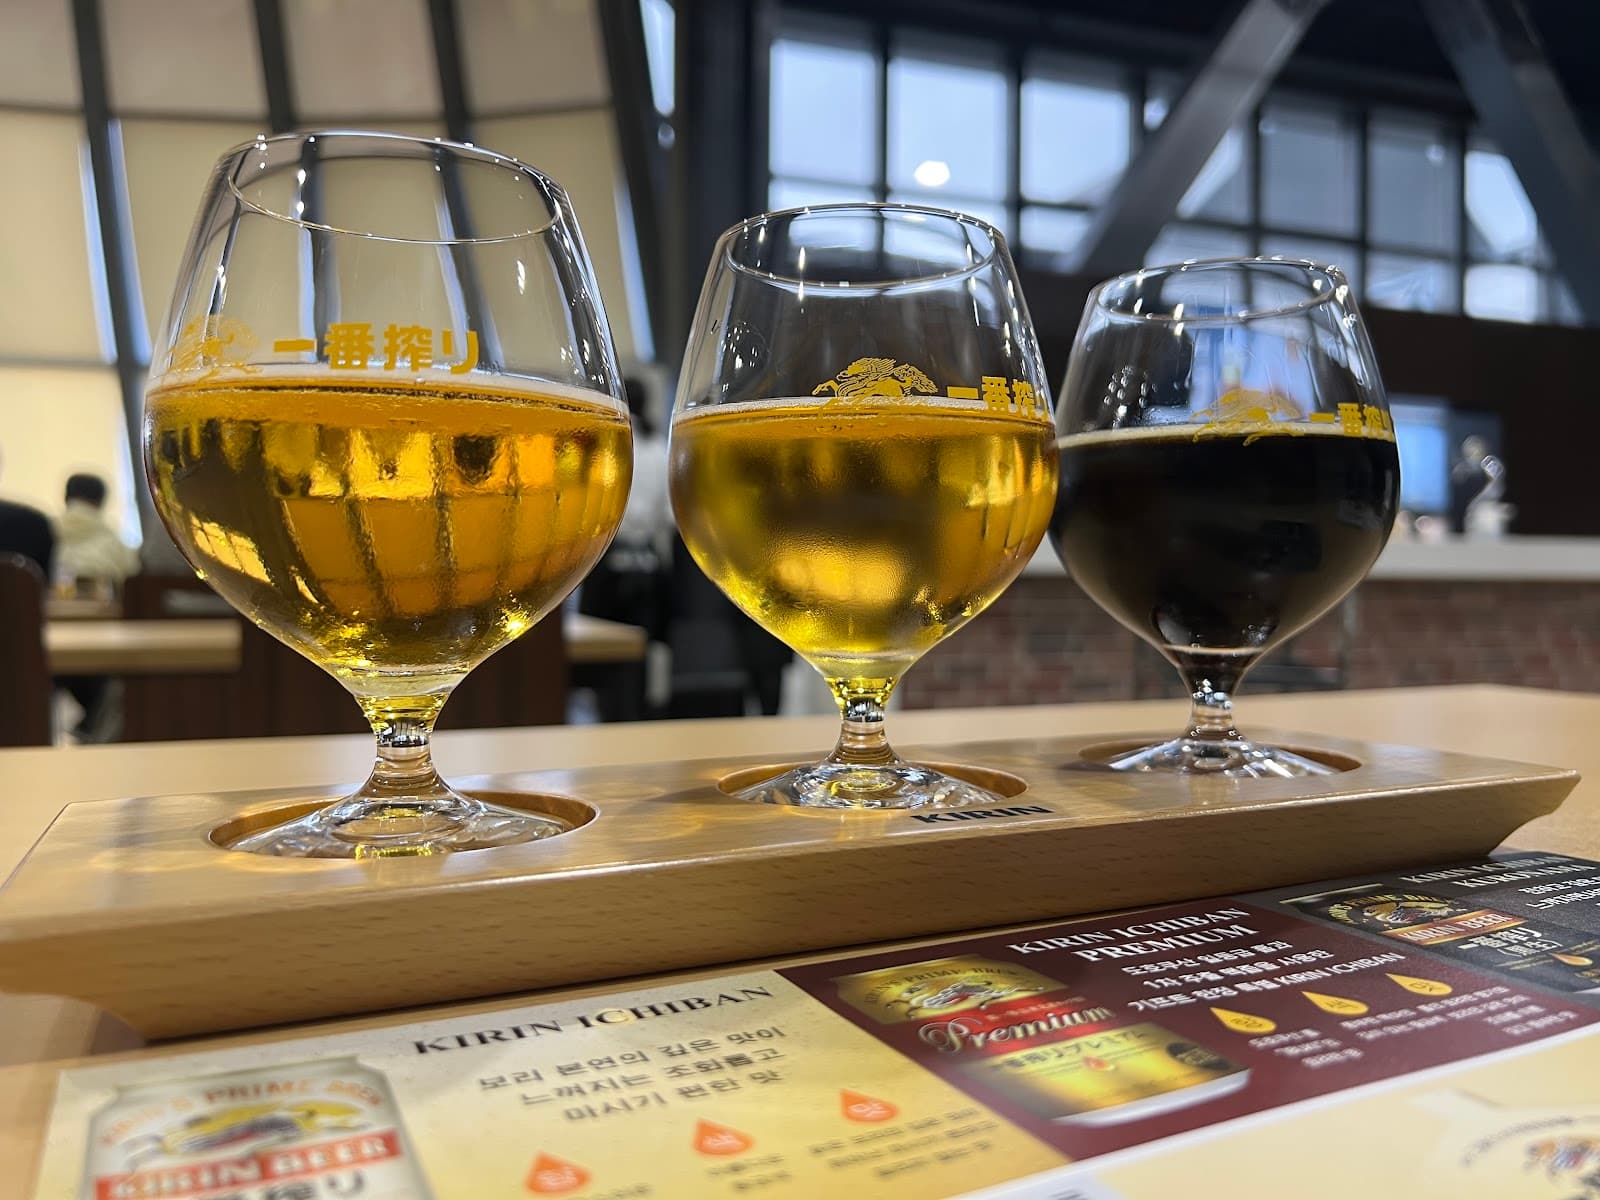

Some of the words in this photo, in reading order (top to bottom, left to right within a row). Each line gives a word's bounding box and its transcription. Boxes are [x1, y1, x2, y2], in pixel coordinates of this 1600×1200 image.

[273, 322, 480, 375] 一番搾り
[909, 805, 1054, 824] KIRIN
[1006, 931, 1115, 954] KIRIN
[1110, 907, 1251, 939] ICHIBAN
[1071, 924, 1260, 962] PREMIUM
[1398, 924, 1465, 942] KIRIN
[1453, 911, 1515, 934] BEER
[1277, 967, 1332, 988] KIRIN
[1326, 951, 1407, 976] ICHIBAN
[412, 1022, 563, 1055] KIRIN
[576, 986, 774, 1029] ICHIBAN
[918, 1004, 1116, 1053] Premium
[479, 1068, 544, 1091] 보리
[555, 1050, 650, 1077] 본연의
[658, 1037, 720, 1059] 깊은
[726, 1025, 786, 1046] 맛이
[519, 1071, 655, 1106] 느껴지는
[661, 1046, 786, 1080] 조화롭고
[562, 1091, 668, 1122] 마시기
[675, 1076, 744, 1100] 편한
[748, 1068, 786, 1086] 맛
